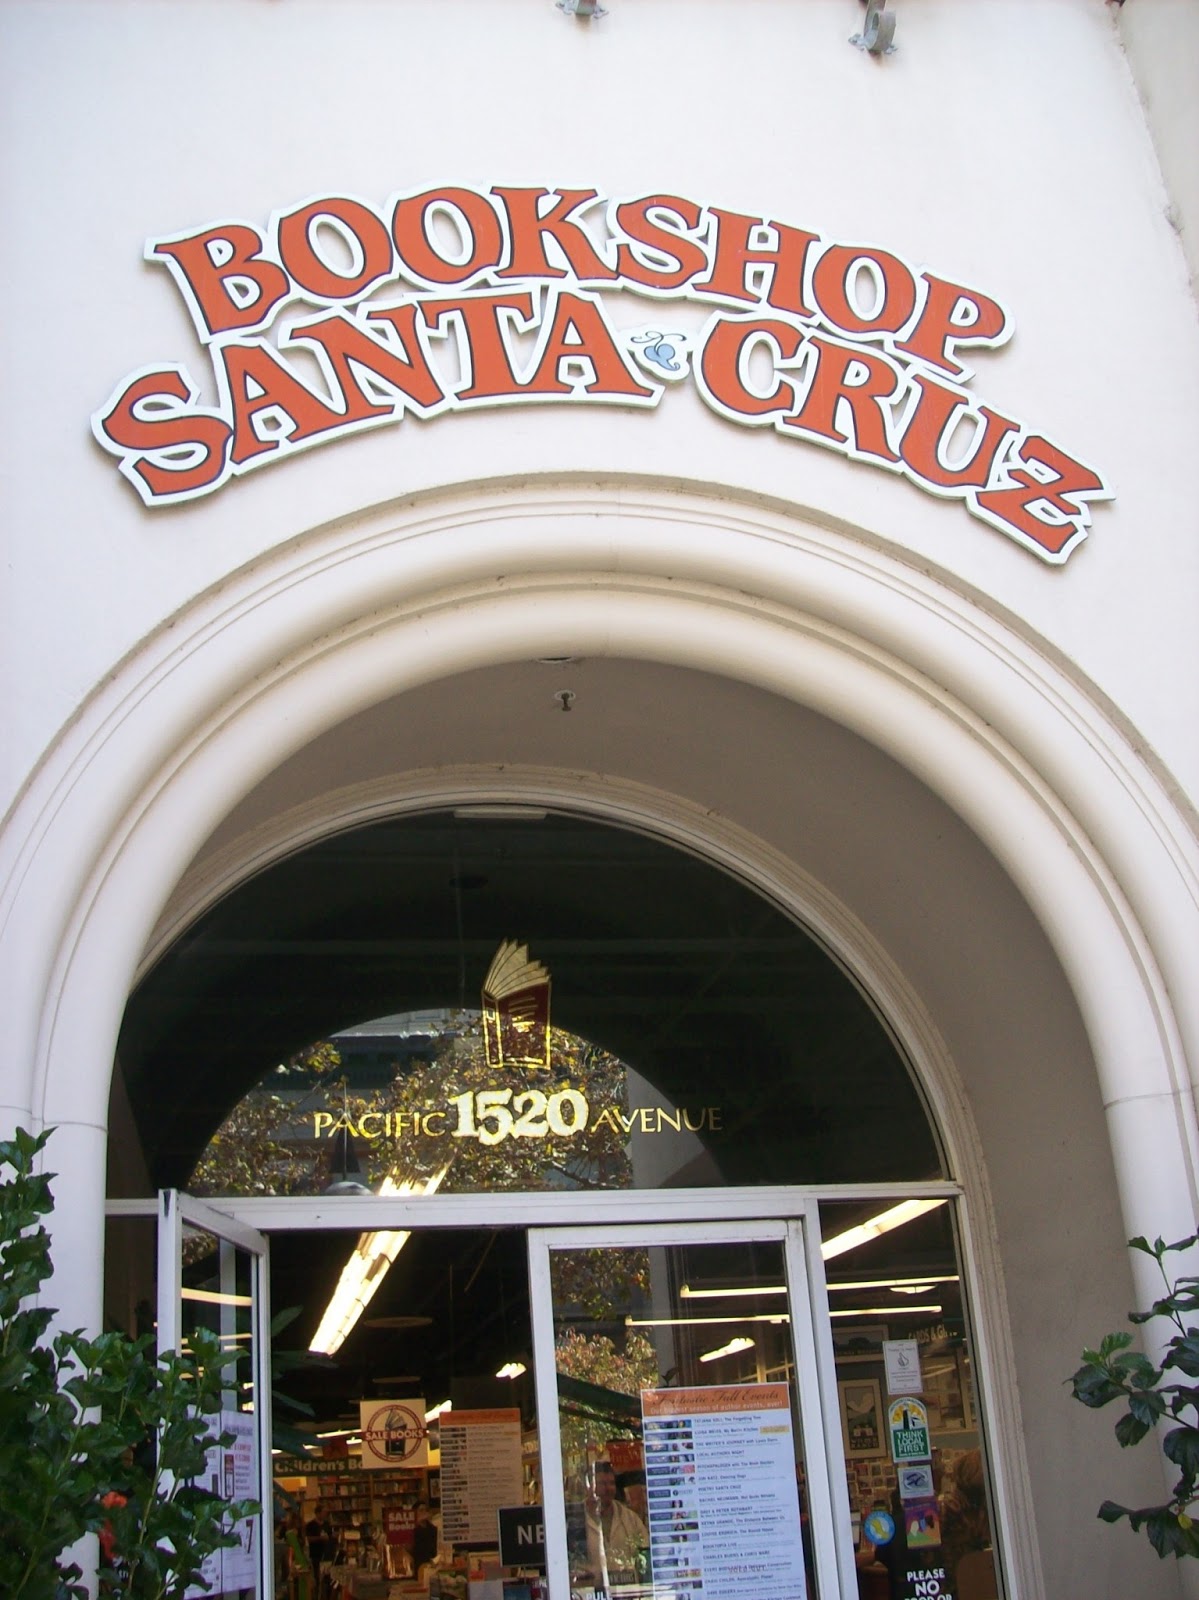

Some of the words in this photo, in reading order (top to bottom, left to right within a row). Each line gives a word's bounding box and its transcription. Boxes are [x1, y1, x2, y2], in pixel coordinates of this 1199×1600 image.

[154, 186, 1005, 375] BOOKSHOP
[102, 291, 655, 496] SANTA
[701, 317, 1104, 553] CRUZ
[313, 1110, 446, 1138] PACIFIC
[448, 1088, 589, 1146] 1520
[591, 1106, 722, 1134] AVENUE
[364, 1430, 388, 1440] SALE
[390, 1428, 424, 1438] BOOKS
[896, 1430, 924, 1440] THINK
[898, 1436, 924, 1446] LOCAL
[898, 1443, 925, 1453] FIRST
[274, 1458, 344, 1472] Cildren's
[388, 1510, 414, 1521] SALE
[517, 1524, 544, 1545] NE
[906, 1568, 944, 1582] PLEASE
[914, 1580, 939, 1596] NO
